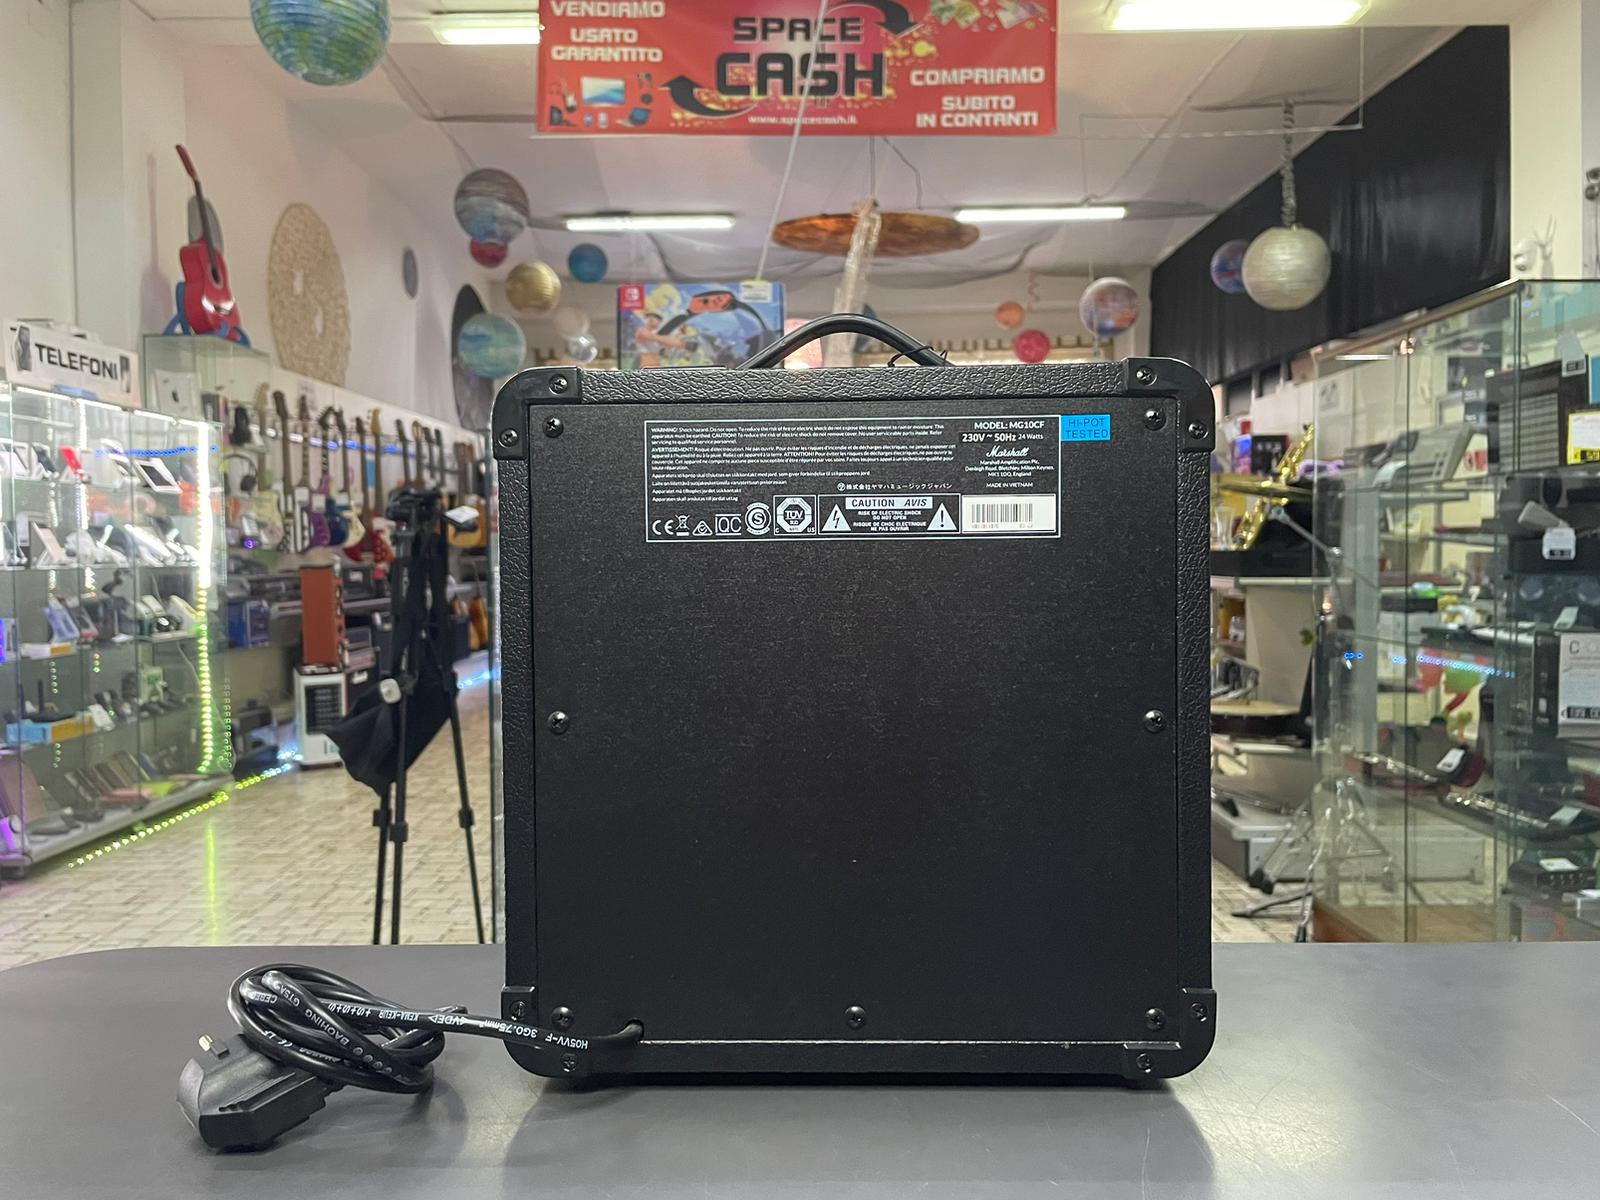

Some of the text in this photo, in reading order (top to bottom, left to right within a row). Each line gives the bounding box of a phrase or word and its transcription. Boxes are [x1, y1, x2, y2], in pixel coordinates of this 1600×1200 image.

[551, 1, 666, 18] VENDIAMO
[570, 28, 638, 43] USATO
[733, 17, 864, 42] SPACE
[551, 46, 663, 62] GARANTITO
[717, 53, 884, 97] CASH
[910, 66, 1046, 86] COMPRIAMO
[942, 95, 1016, 111] SUBITO
[916, 112, 1039, 128] IN CONTANTI
[35, 343, 118, 380] TELEFONI
[1068, 418, 1105, 427] HI-POT
[962, 433, 985, 442] 230V
[994, 433, 1017, 442] 50Hz
[1065, 429, 1108, 439] TESTED
[986, 445, 1030, 457] Marshall
[852, 499, 895, 507] CAUTION
[305, 1009, 350, 1046] BAOHING
[545, 1033, 589, 1049] H05VV-F
